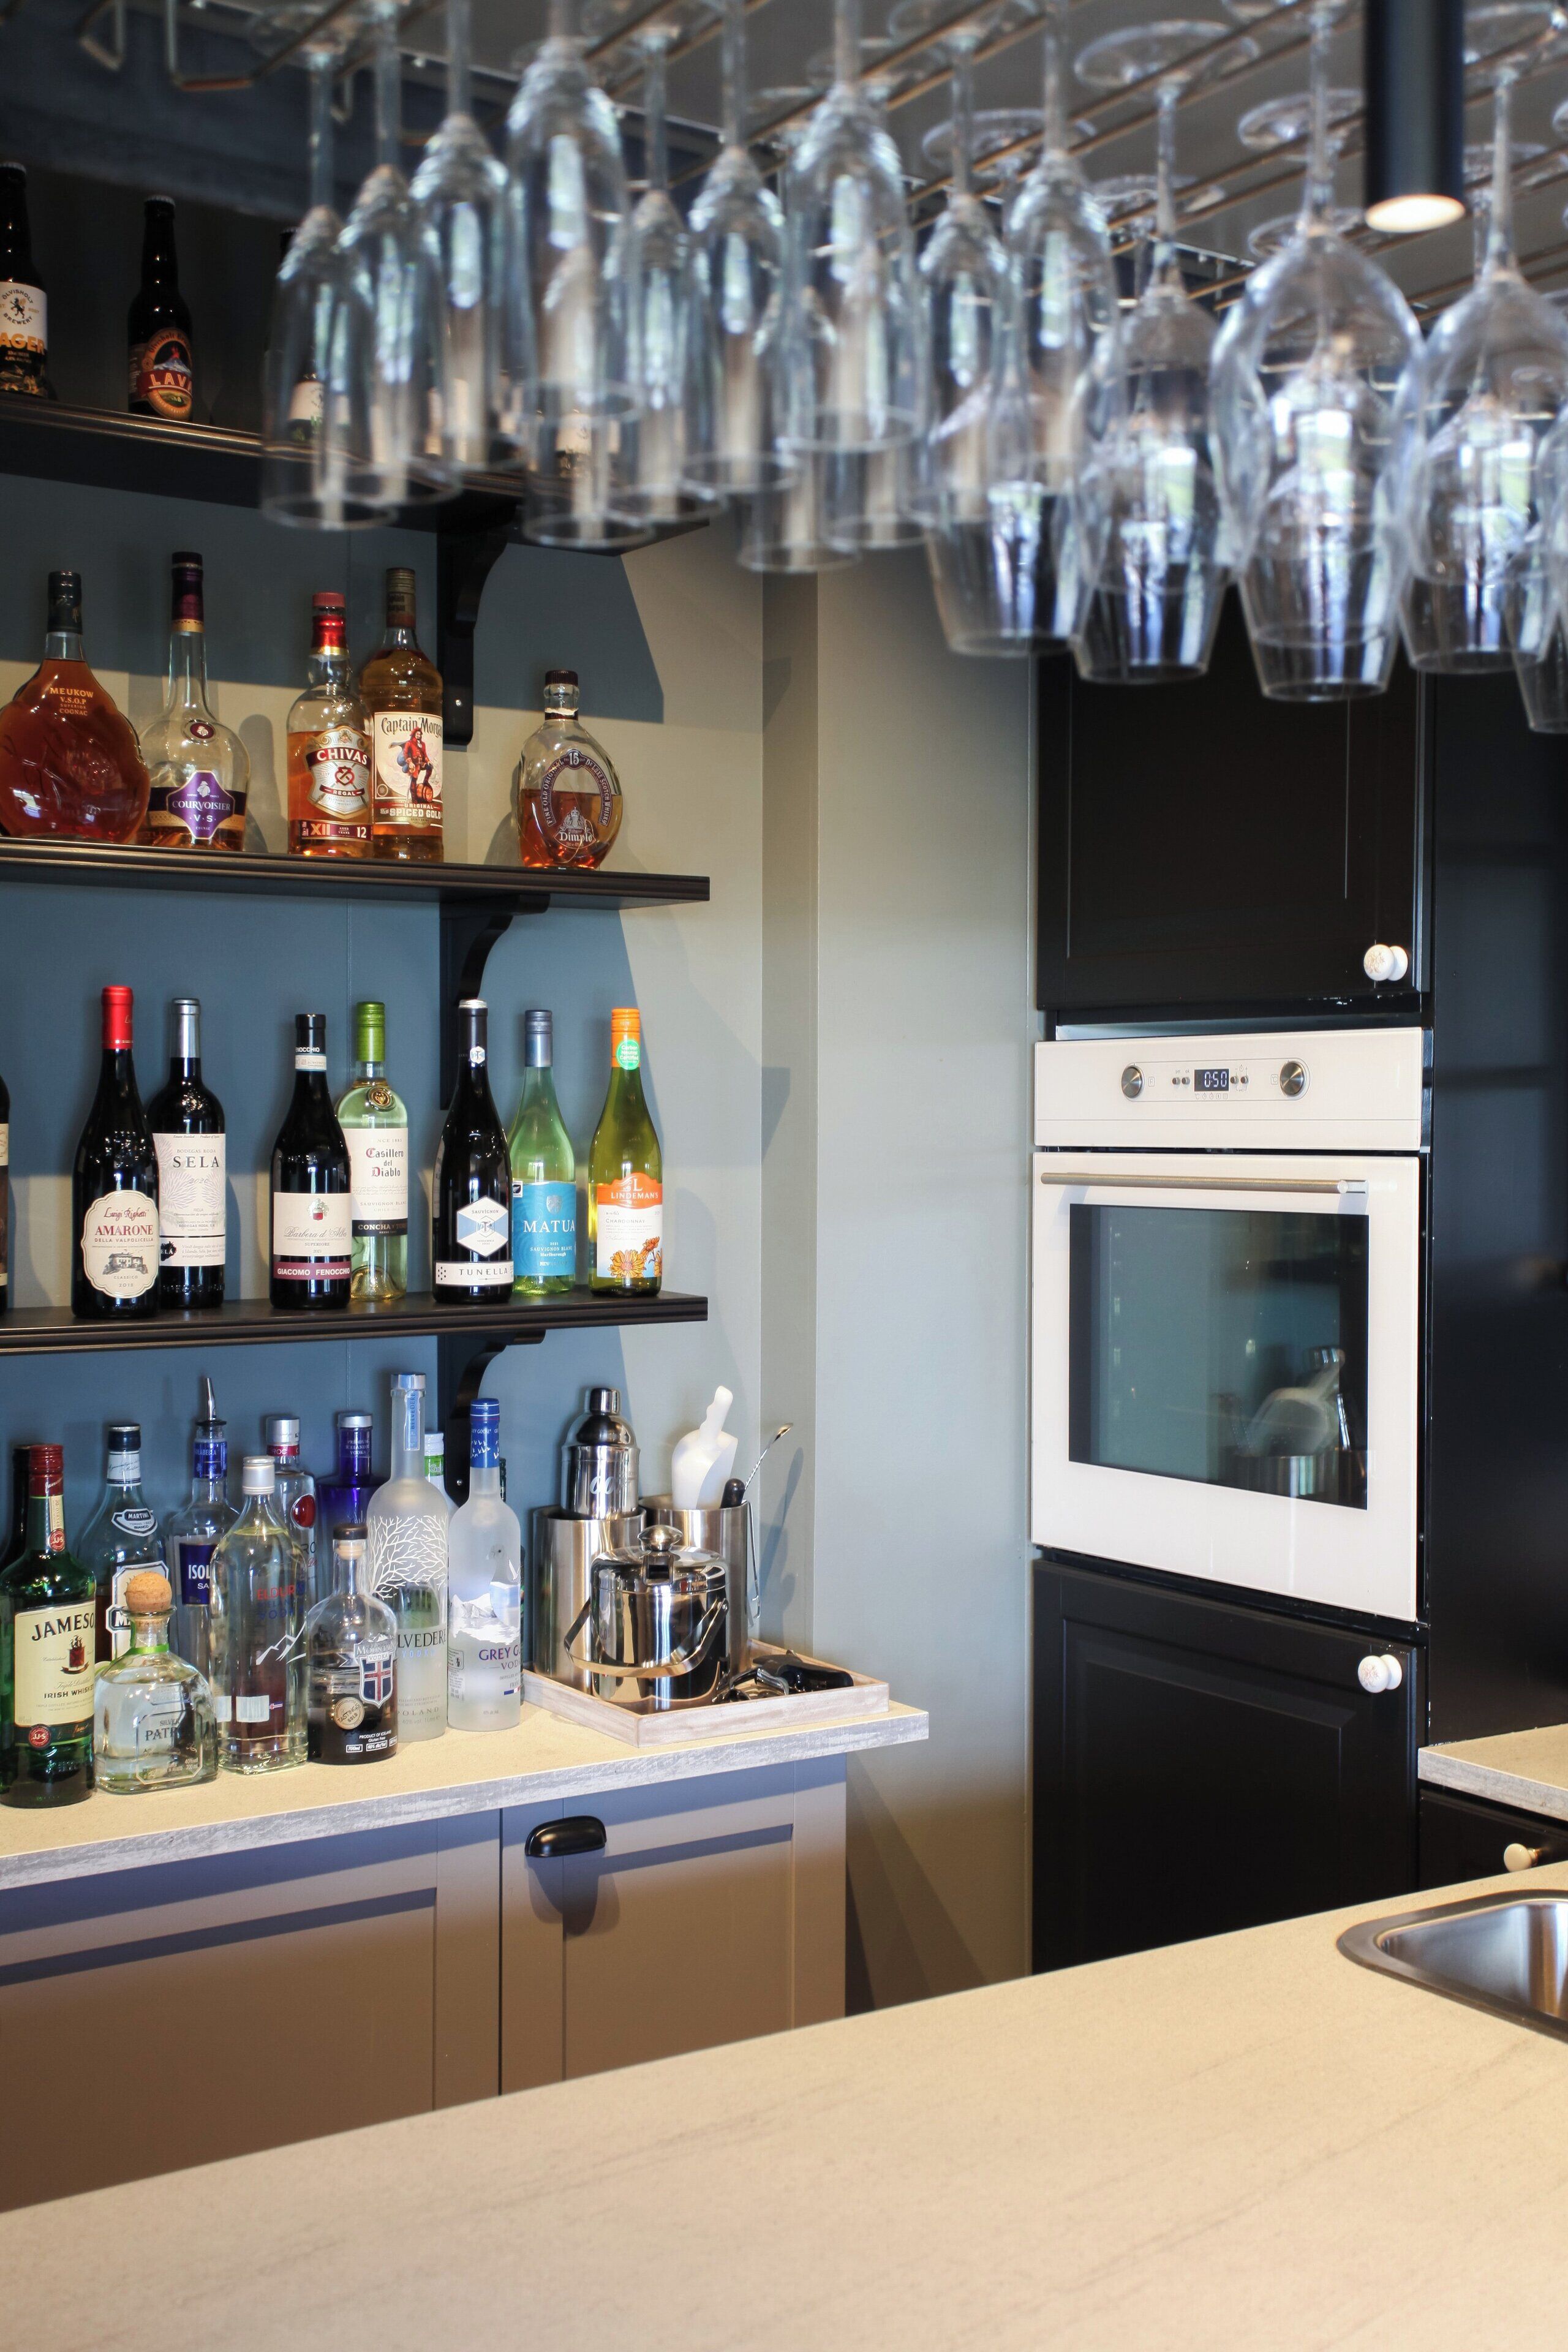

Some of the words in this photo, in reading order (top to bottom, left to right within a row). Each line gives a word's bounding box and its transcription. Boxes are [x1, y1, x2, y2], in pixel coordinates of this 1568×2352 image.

[4, 312, 32, 325] BREWERY
[0, 332, 45, 355] AGER
[50, 687, 94, 698] MEUKOW
[381, 717, 418, 735] Captain
[418, 717, 442, 739] Morga
[317, 748, 368, 765] CHIVAS
[569, 752, 579, 766] 15
[599, 778, 610, 801] SCOTCH
[172, 801, 230, 812] COURVOISIER
[390, 807, 424, 818] SPICED
[543, 807, 553, 825] FINE
[311, 823, 331, 835] XII
[356, 827, 367, 839] 12
[1204, 1071, 1227, 1088] 0:50
[366, 1147, 404, 1158] Casillero
[173, 1156, 219, 1168] SELA
[372, 1167, 401, 1177] Diablo
[104, 1207, 123, 1221] Luigi
[124, 1207, 147, 1221] Righetti
[95, 1225, 153, 1236] AMARONE
[284, 1226, 317, 1237] Barbera
[523, 1219, 575, 1233] MATUA
[188, 1564, 209, 1579] ISOL
[31, 1612, 94, 1642] JAMESO
[398, 1629, 447, 1649] LVEDERE
[479, 1647, 511, 1660] GREY
[501, 1659, 521, 1670] VOD
[71, 1684, 94, 1696] WHISKE
[337, 1703, 361, 1723] TASTINGS
[159, 1718, 179, 1727] SILVER
[145, 1726, 178, 1741] PATR
